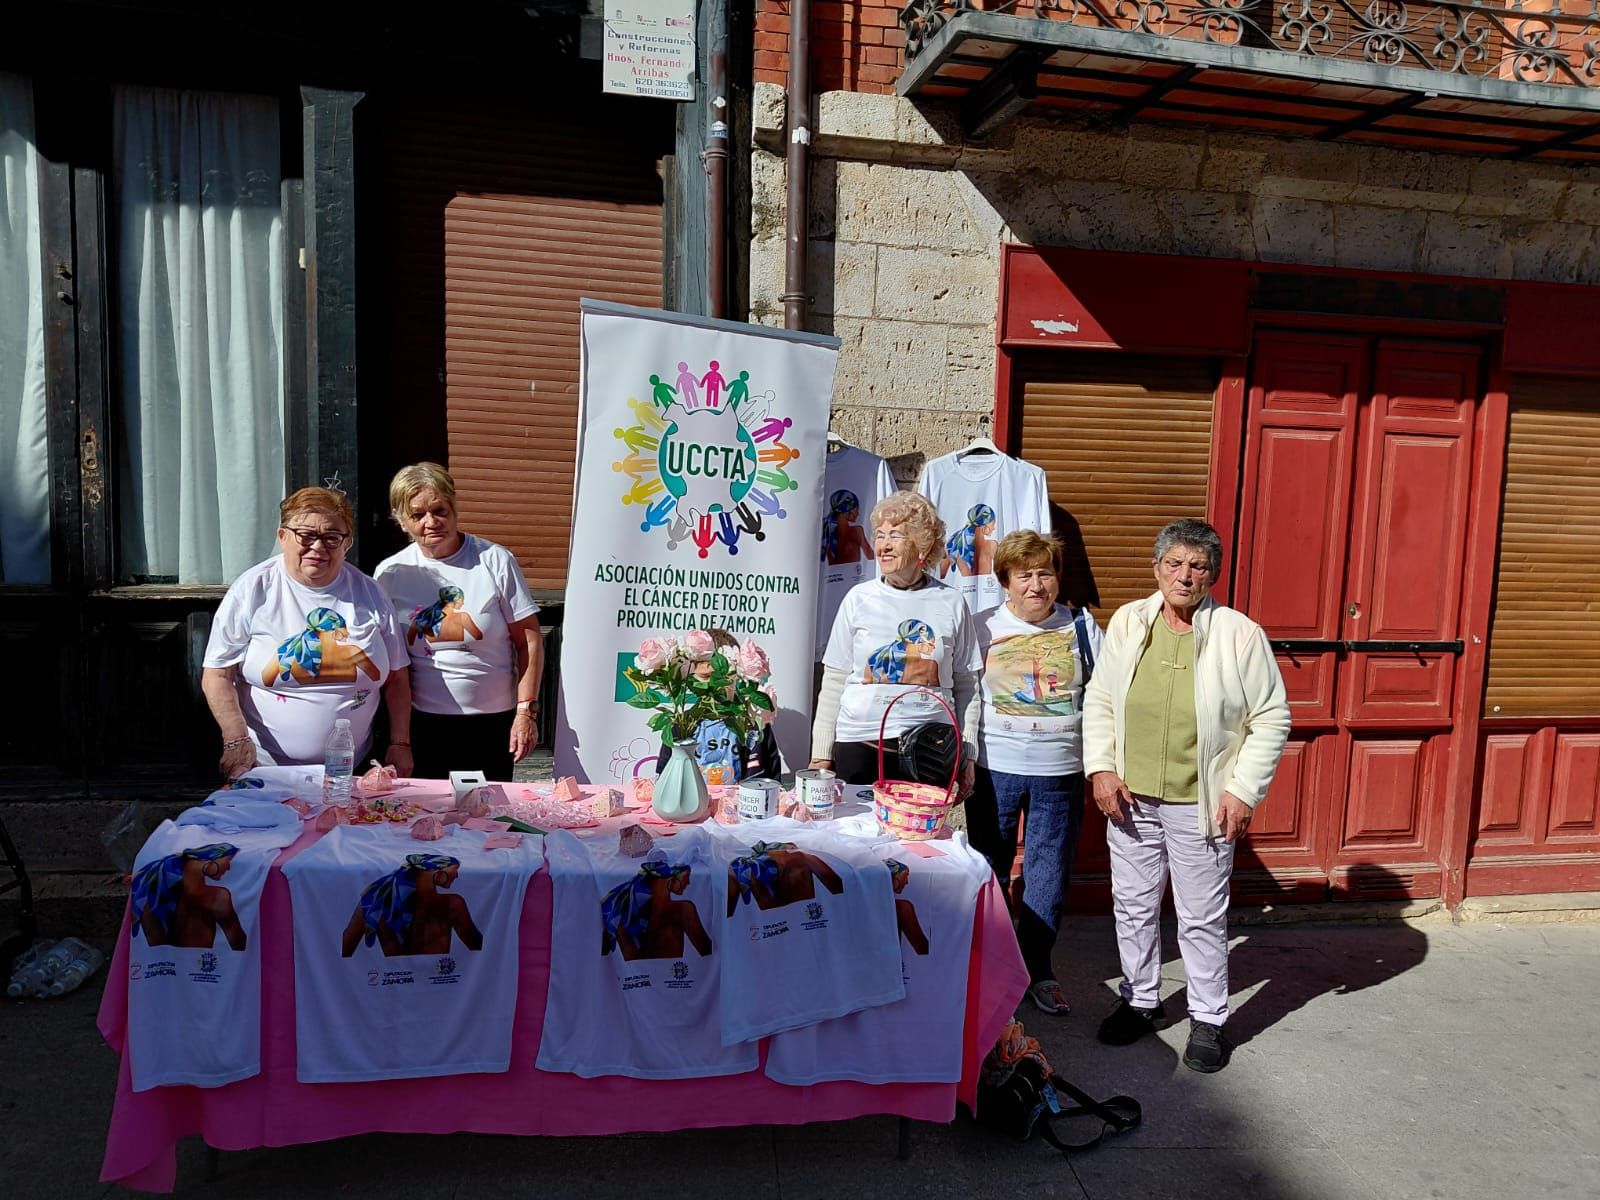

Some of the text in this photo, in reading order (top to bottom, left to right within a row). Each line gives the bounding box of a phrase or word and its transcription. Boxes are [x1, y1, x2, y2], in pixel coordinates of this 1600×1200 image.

[607, 30, 692, 46] Construcciones
[607, 52, 635, 64] Hnos.
[628, 42, 681, 55] Reformas
[631, 66, 670, 78] Arribas
[668, 441, 746, 481] UCCTA
[594, 563, 800, 594] ASOCIACIÓN UNIDOS CONTRA
[624, 586, 770, 613] EL CÁNCER DE TORO Y
[617, 610, 776, 634] PROVINCIA DE ZAMORA
